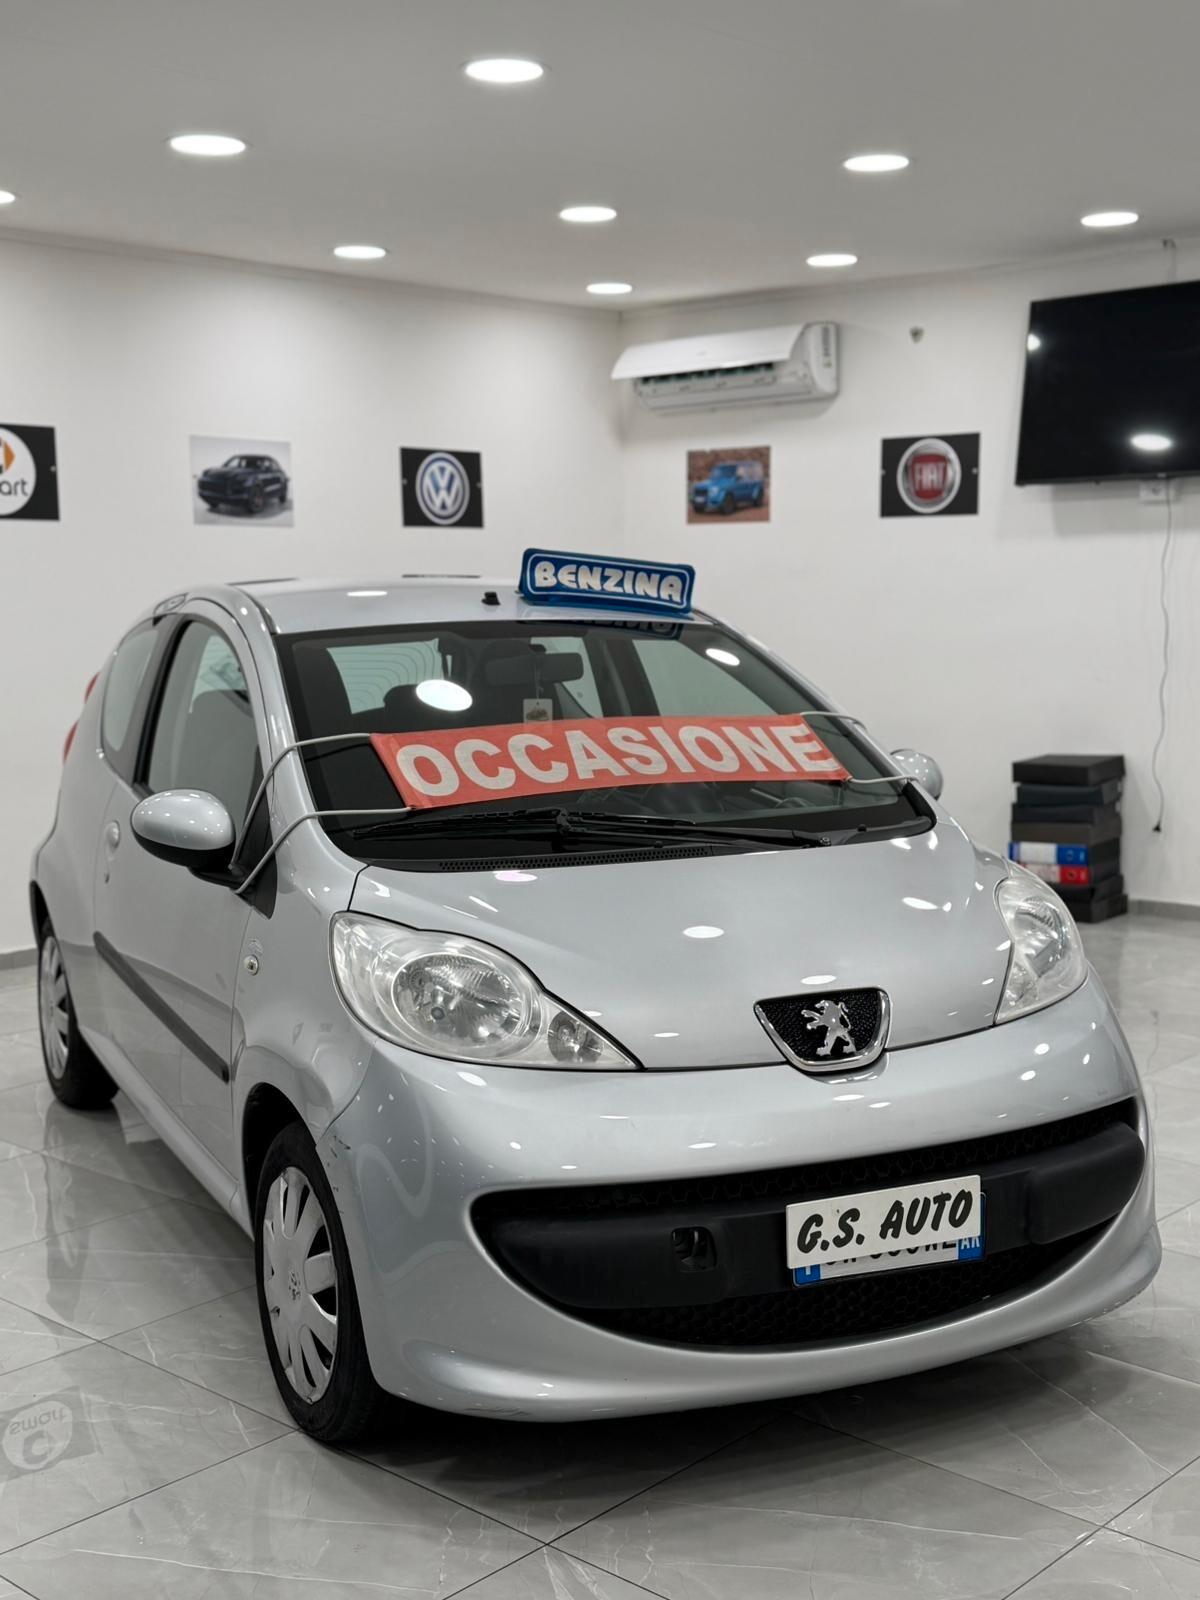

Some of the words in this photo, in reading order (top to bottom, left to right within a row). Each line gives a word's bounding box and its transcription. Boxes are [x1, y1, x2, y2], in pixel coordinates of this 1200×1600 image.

[914, 462, 946, 491] FIAT
[535, 561, 683, 602] BENZINA
[396, 722, 841, 797] OCCASIONE
[797, 1208, 865, 1254] G.S.
[879, 1189, 973, 1240] AUTO
